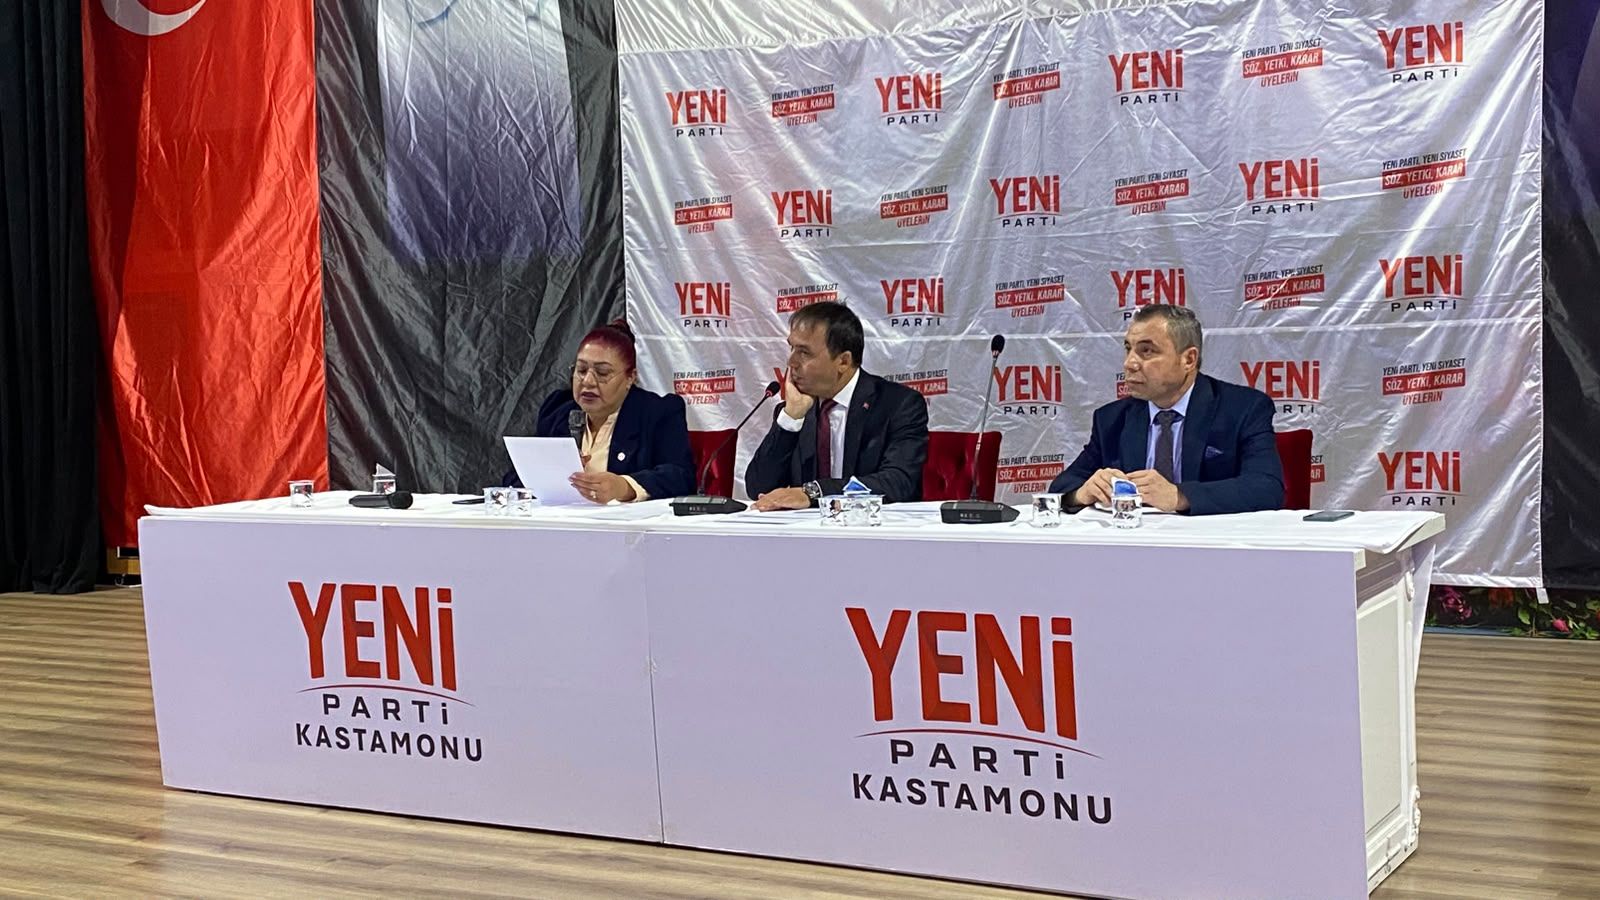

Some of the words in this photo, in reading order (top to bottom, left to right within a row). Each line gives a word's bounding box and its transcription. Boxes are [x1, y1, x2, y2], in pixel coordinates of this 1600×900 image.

[1435, 162, 1463, 178] KARAR
[1434, 372, 1463, 386] KARAR
[296, 722, 482, 762] KASTAMONU
[852, 772, 1112, 824] KASTAMONU
